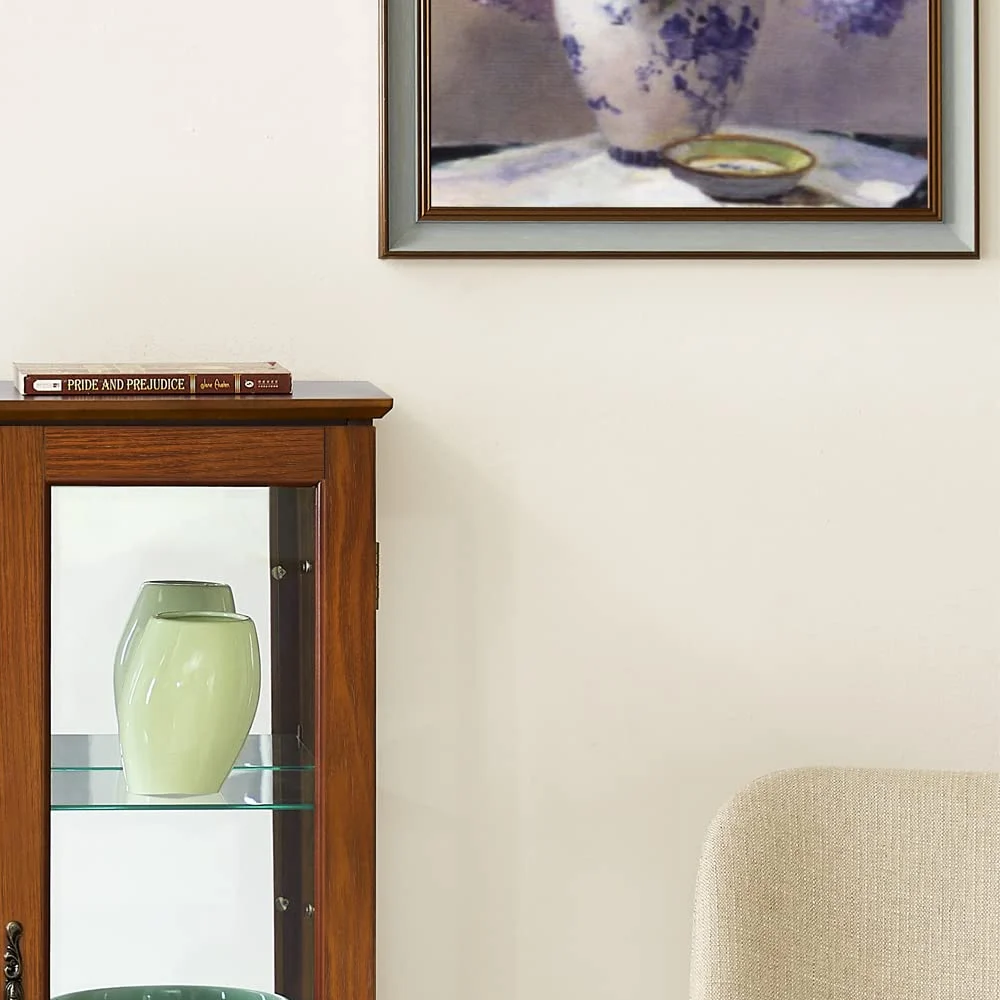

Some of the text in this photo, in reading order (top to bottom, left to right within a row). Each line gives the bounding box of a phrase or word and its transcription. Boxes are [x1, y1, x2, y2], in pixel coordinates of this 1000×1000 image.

[67, 378, 99, 391] PRIDE
[101, 378, 124, 391] AND
[126, 378, 185, 391] PREJUDICE
